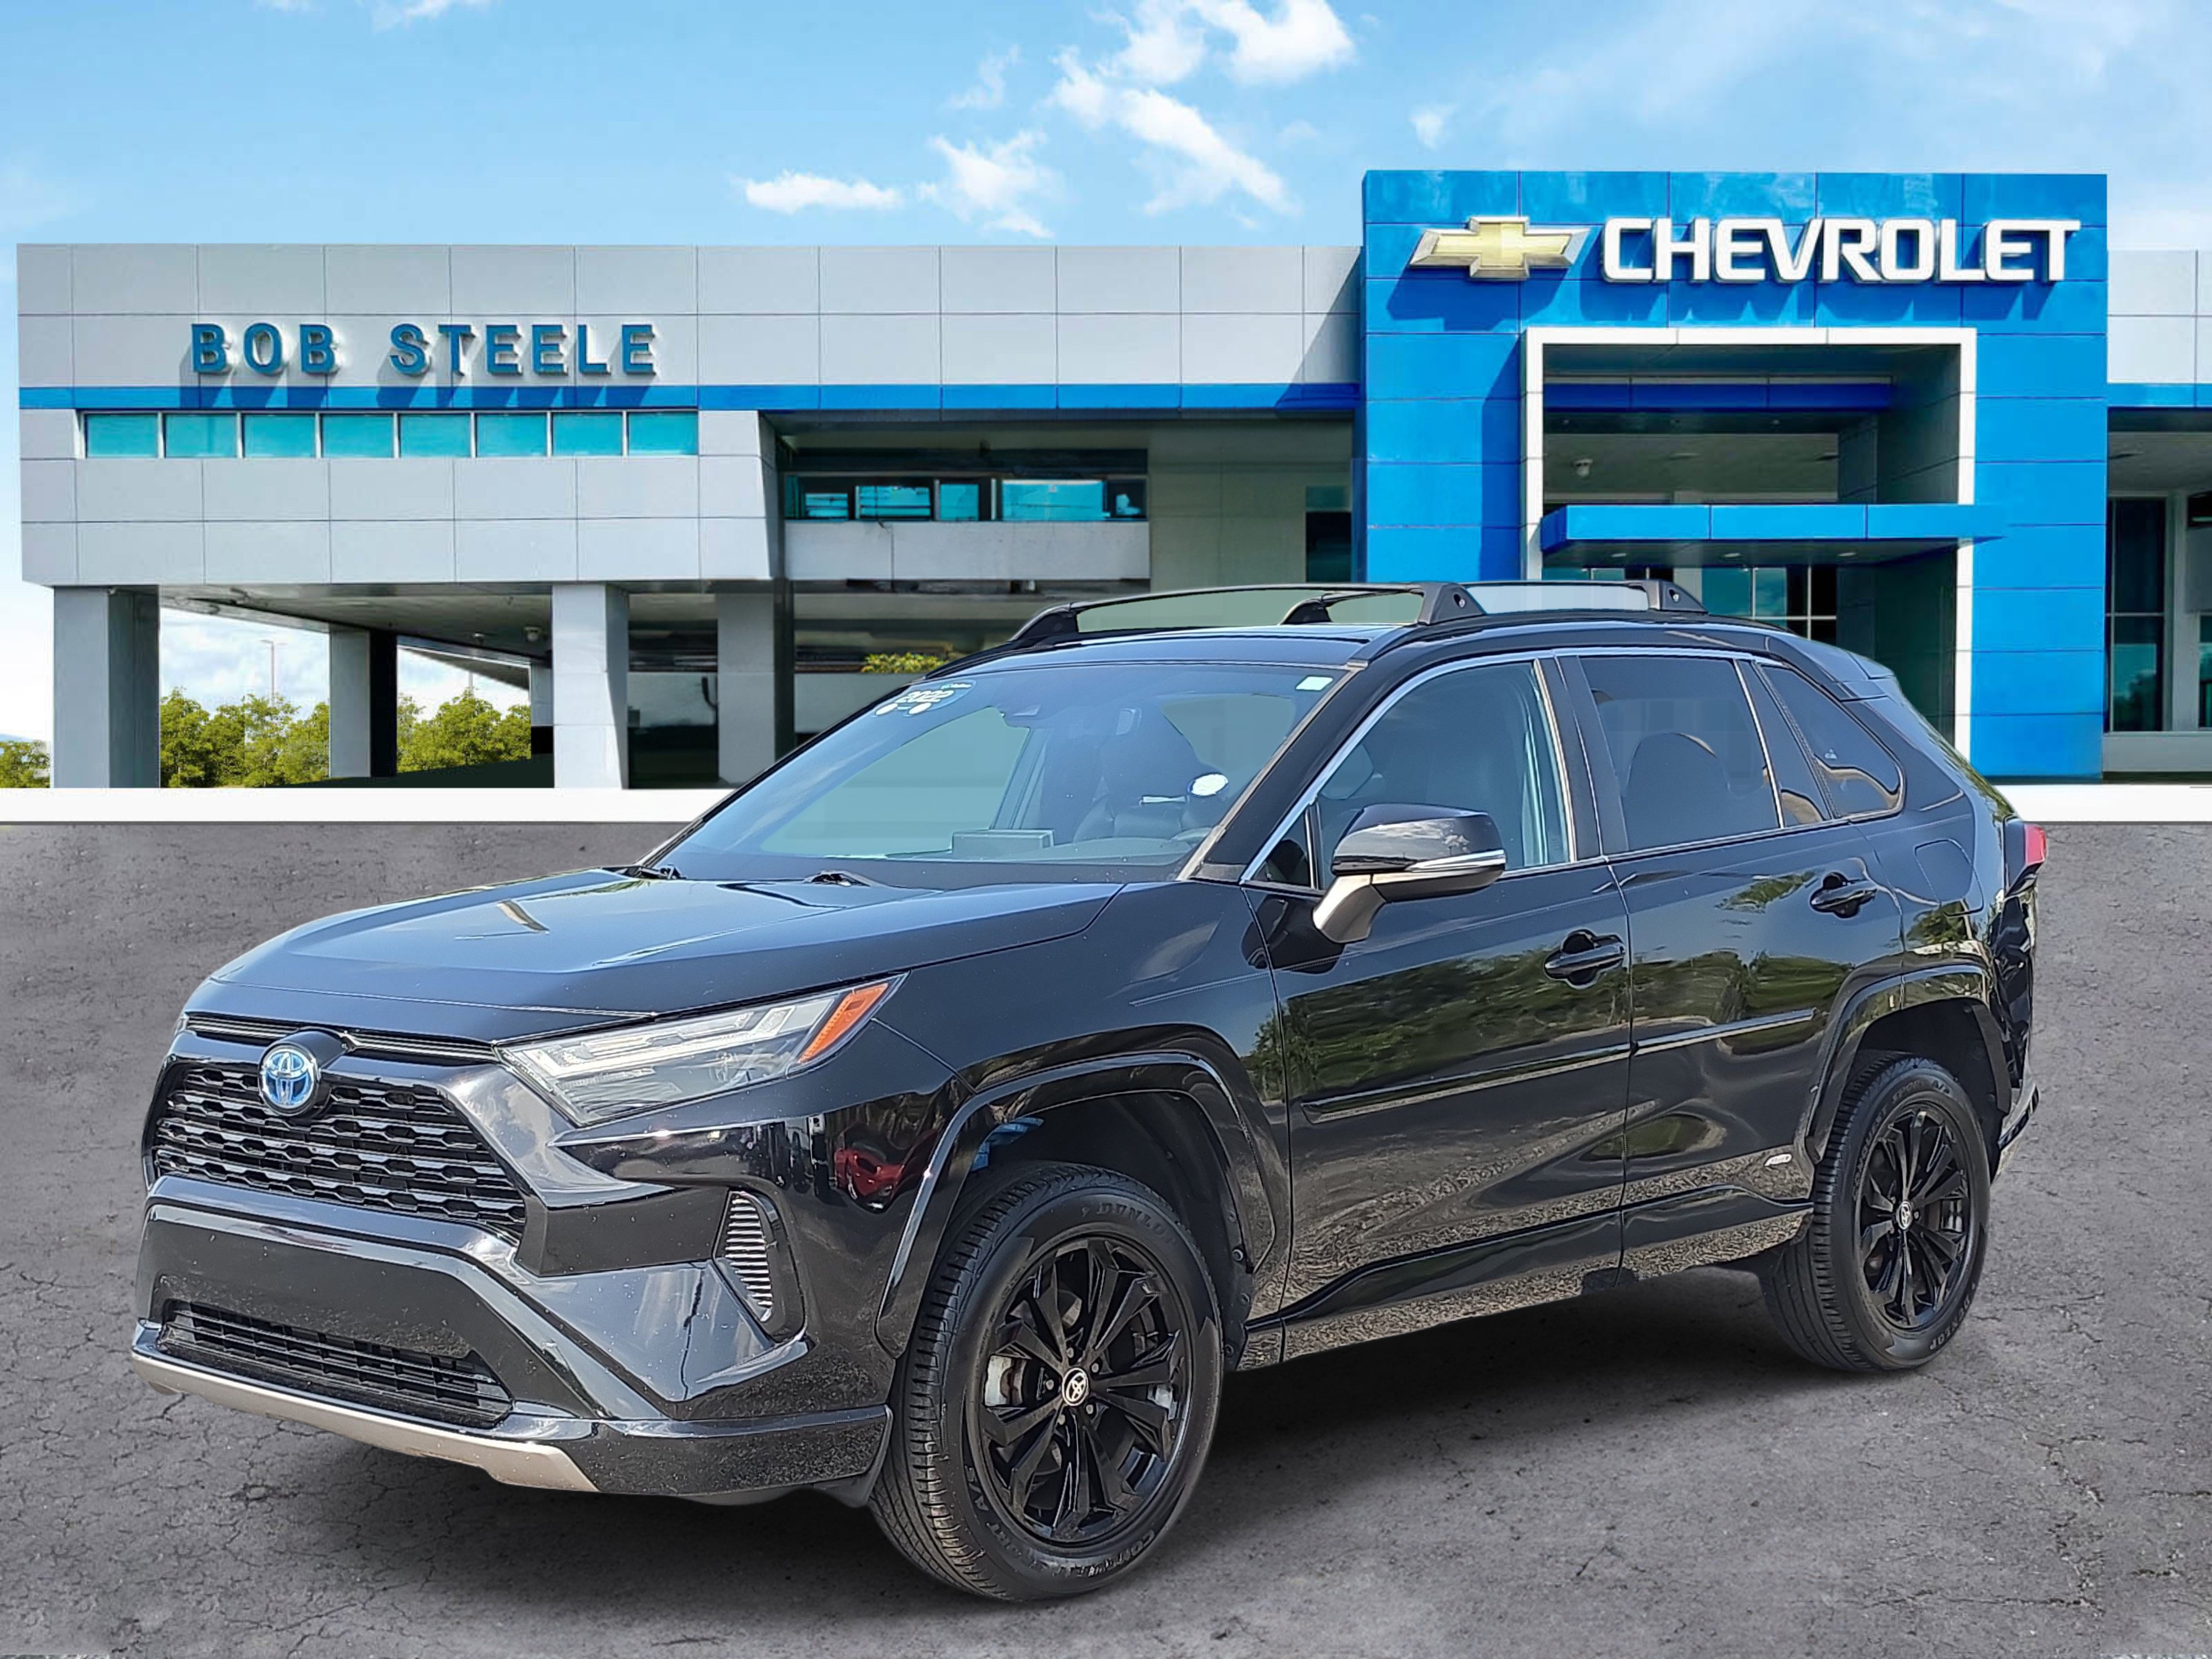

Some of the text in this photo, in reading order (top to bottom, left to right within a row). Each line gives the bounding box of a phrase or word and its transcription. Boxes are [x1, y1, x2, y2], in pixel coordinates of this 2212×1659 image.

[1601, 217, 2081, 283] CHEVROLET
[190, 322, 658, 376] BOB STEELE
[1096, 1202, 1178, 1246] DUNLOP
[1929, 1293, 1971, 1350] DUNLOP
